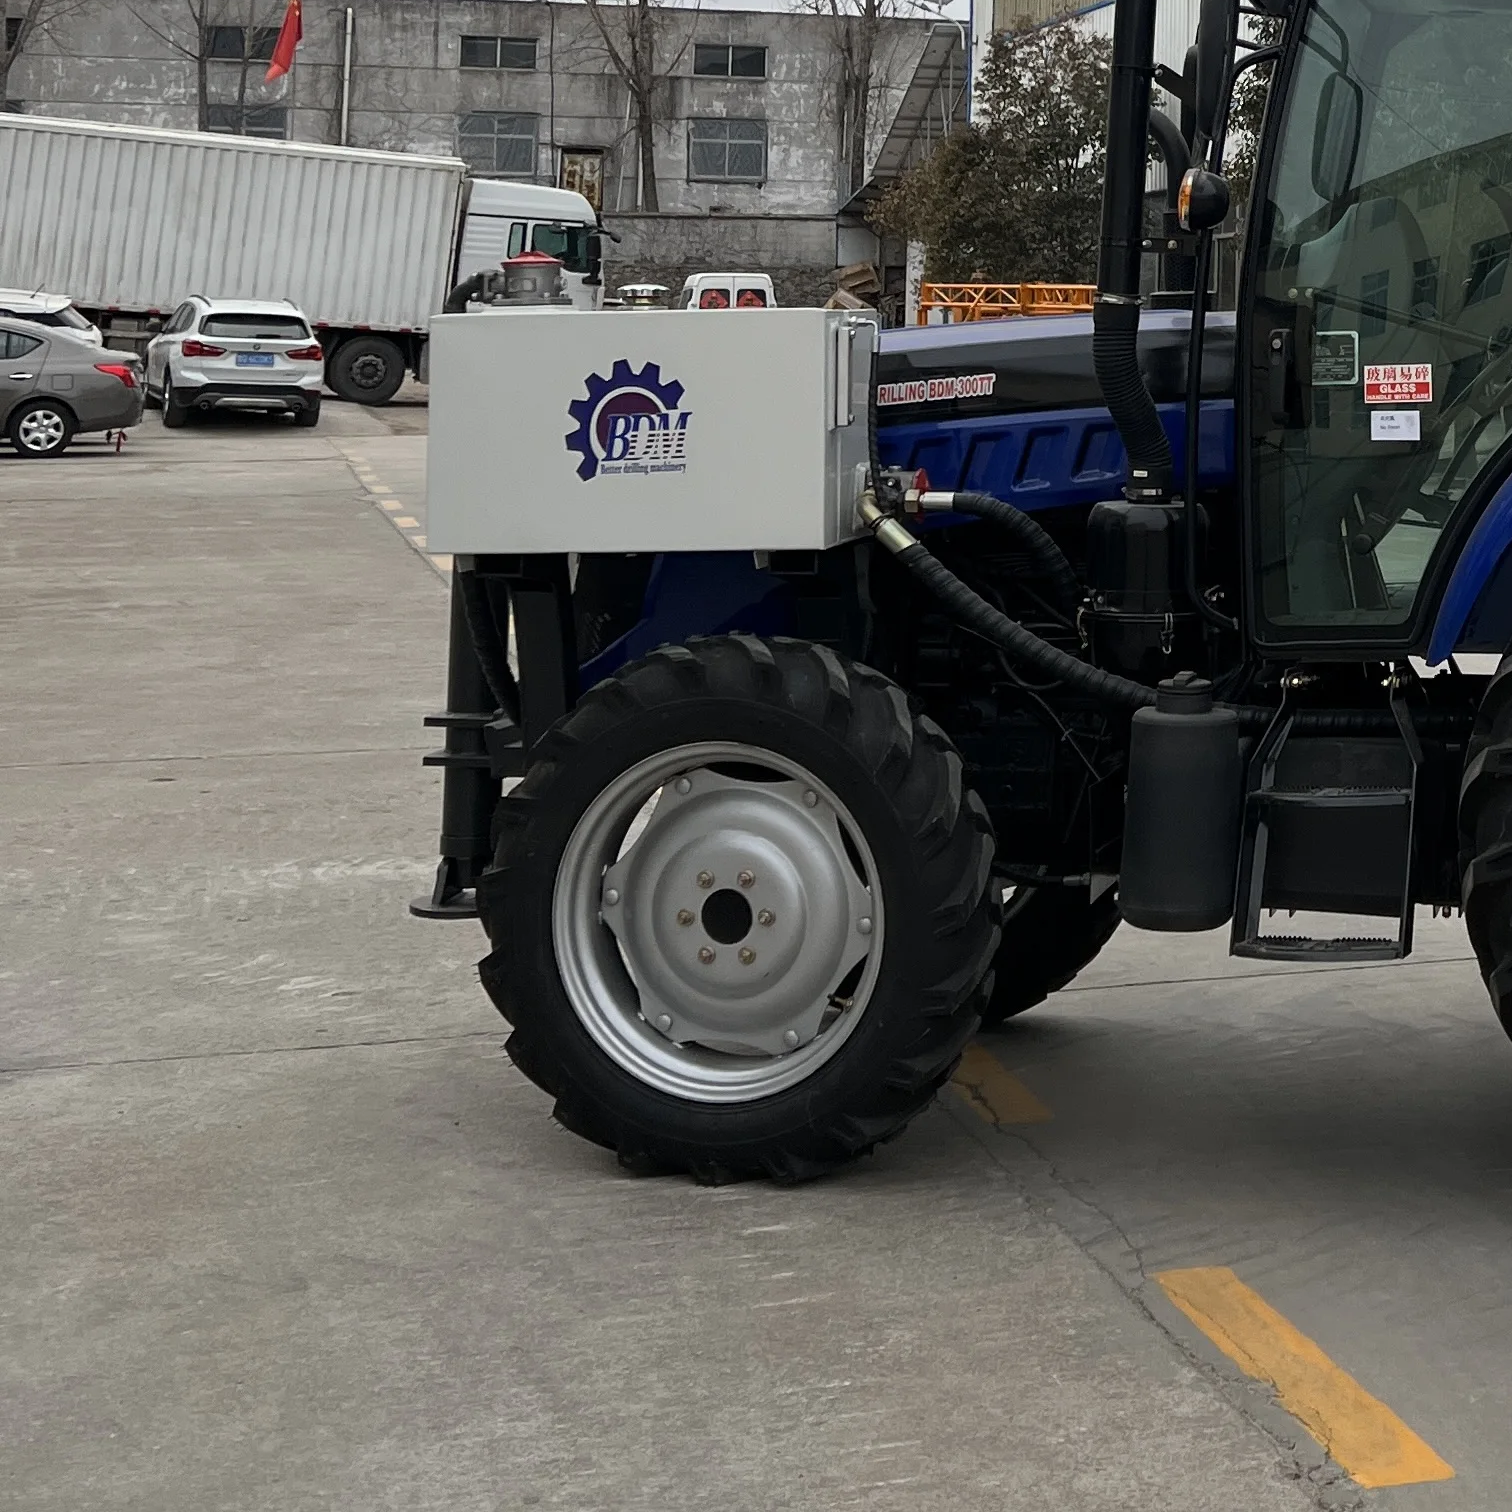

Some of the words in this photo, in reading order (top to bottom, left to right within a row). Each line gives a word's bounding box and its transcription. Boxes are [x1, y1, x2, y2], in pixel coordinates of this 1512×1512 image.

[1366, 366, 1429, 382] 玻璃易碎
[928, 375, 994, 400] BDM-300TT
[1379, 383, 1417, 394] GLASS
[601, 411, 693, 462] BDM
[600, 464, 622, 474] Better
[623, 463, 649, 476] drilling
[650, 461, 686, 474] machinery
